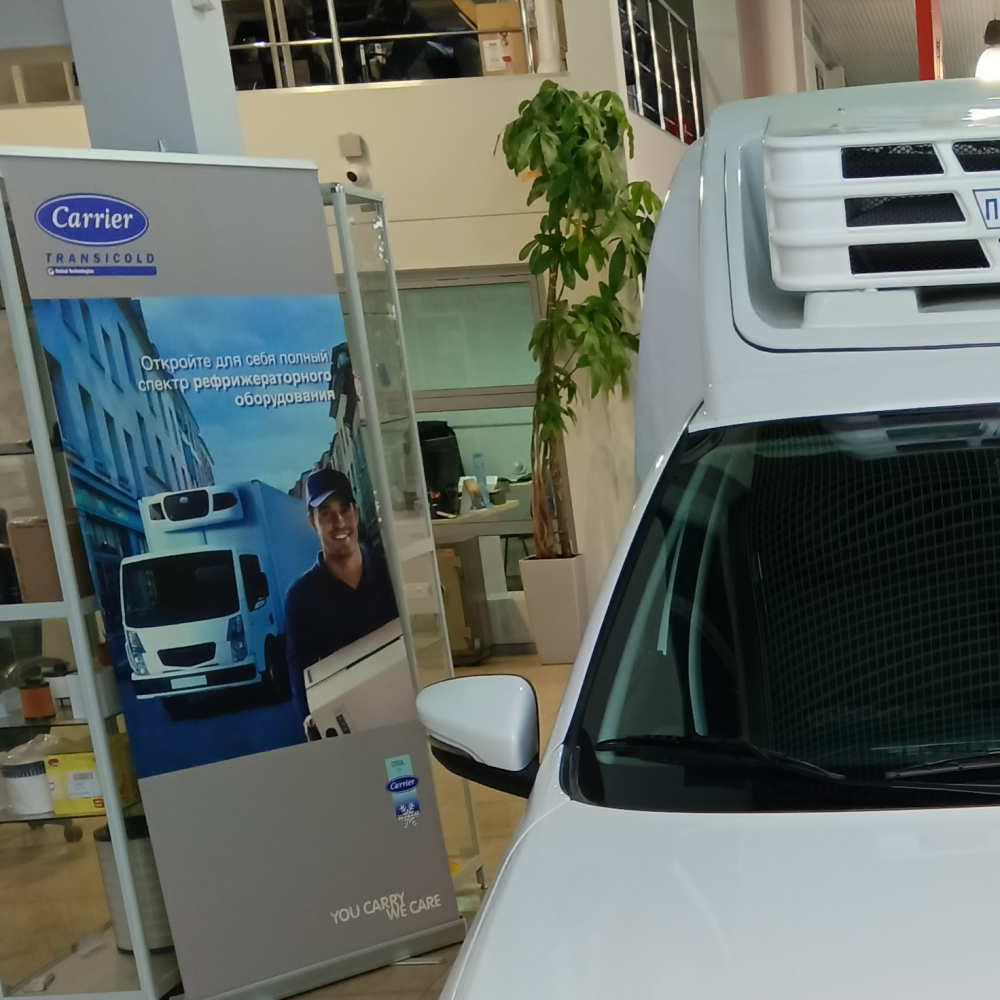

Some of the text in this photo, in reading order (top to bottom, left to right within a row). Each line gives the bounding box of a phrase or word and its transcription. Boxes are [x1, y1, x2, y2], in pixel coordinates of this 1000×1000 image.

[52, 205, 134, 229] Carrier
[46, 252, 155, 264] TRANSICOLD
[140, 349, 331, 372] Откройте для себя полный
[138, 369, 332, 394] спектр рефрижераторного
[234, 389, 336, 409] оборудования
[389, 779, 416, 790] Carrier
[329, 891, 405, 924] YOU CARRY
[386, 894, 442, 920] WE CARE
